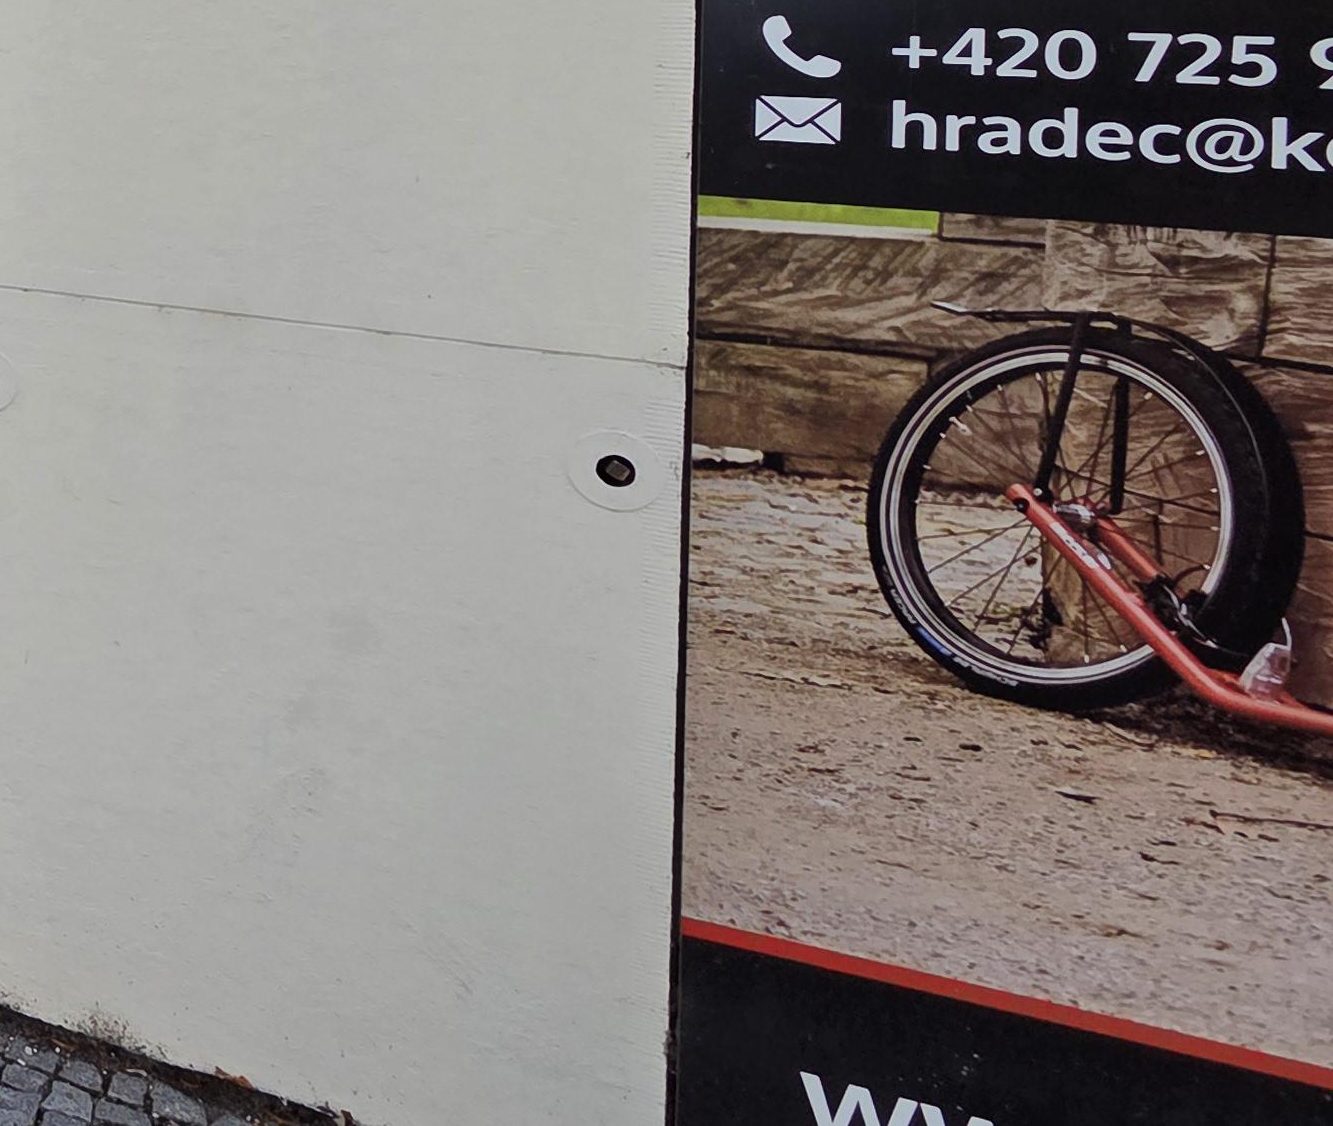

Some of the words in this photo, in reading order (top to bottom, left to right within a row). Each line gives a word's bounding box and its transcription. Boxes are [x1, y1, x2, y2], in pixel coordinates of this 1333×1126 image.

[891, 27, 1097, 80] +420
[1127, 32, 1278, 87] 725
[891, 99, 1333, 174] hradec@k
